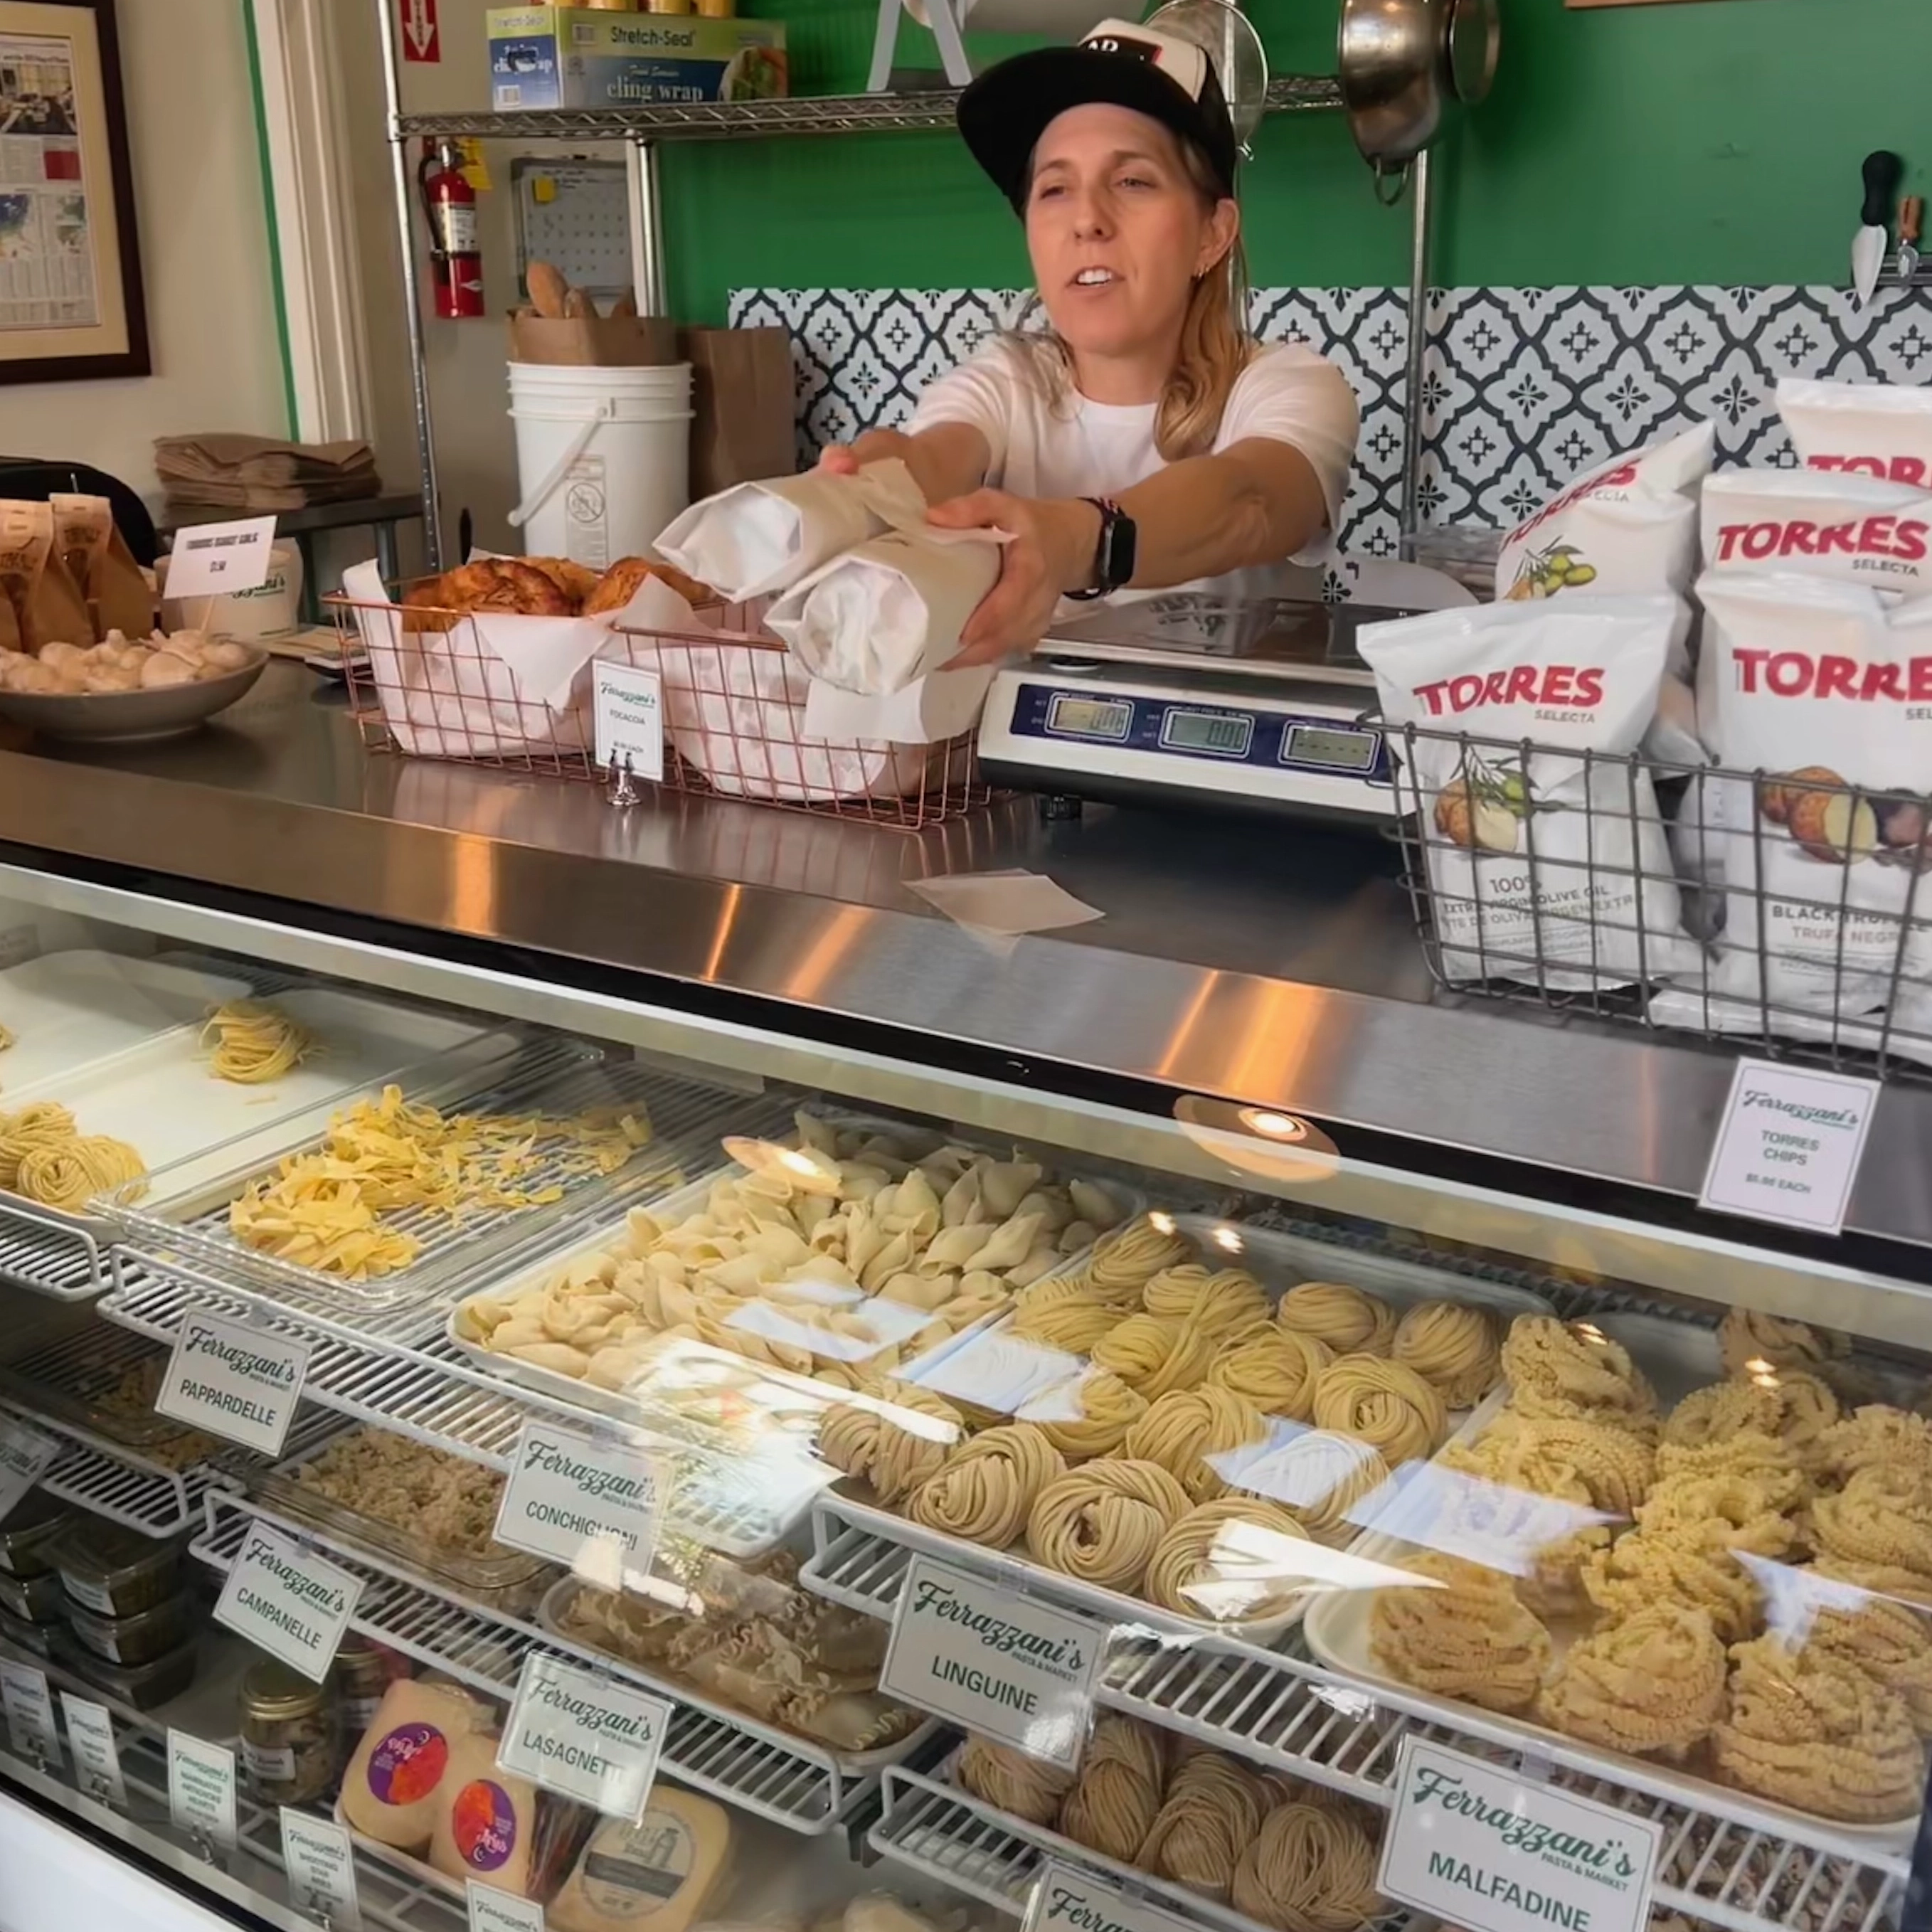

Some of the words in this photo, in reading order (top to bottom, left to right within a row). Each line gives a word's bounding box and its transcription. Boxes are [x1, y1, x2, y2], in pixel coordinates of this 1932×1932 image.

[610, 26, 694, 47] Stretch-Seal
[606, 75, 653, 102] cling
[659, 83, 704, 102] wrap
[1717, 516, 1930, 561] TORRES
[1852, 558, 1920, 577] SELECTA
[1411, 665, 1605, 716] TORRES
[1534, 709, 1596, 724] SELECTA
[1772, 904, 1835, 923] BLACK
[1742, 1089, 1859, 1125] Ferrazzani's
[1761, 1130, 1820, 1152] TORRES
[1763, 1147, 1808, 1167] CHIPS
[186, 1325, 296, 1383] Ferrazzani's
[179, 1379, 277, 1427] PAPPARDELLE
[245, 1538, 346, 1612] Ferrazzani's
[236, 1587, 322, 1650] CAMPANELLE
[913, 1579, 1086, 1671] Ferrazzani's
[930, 1655, 1039, 1716] LINGUINE
[527, 1676, 653, 1742] Ferrazzani's
[1413, 1766, 1637, 1878] Ferrazzani's
[1428, 1851, 1591, 1932] MALFADINE
[1540, 1851, 1573, 1872] PASTA
[1573, 1864, 1583, 1876] &
[1584, 1867, 1630, 1892] MARKET
